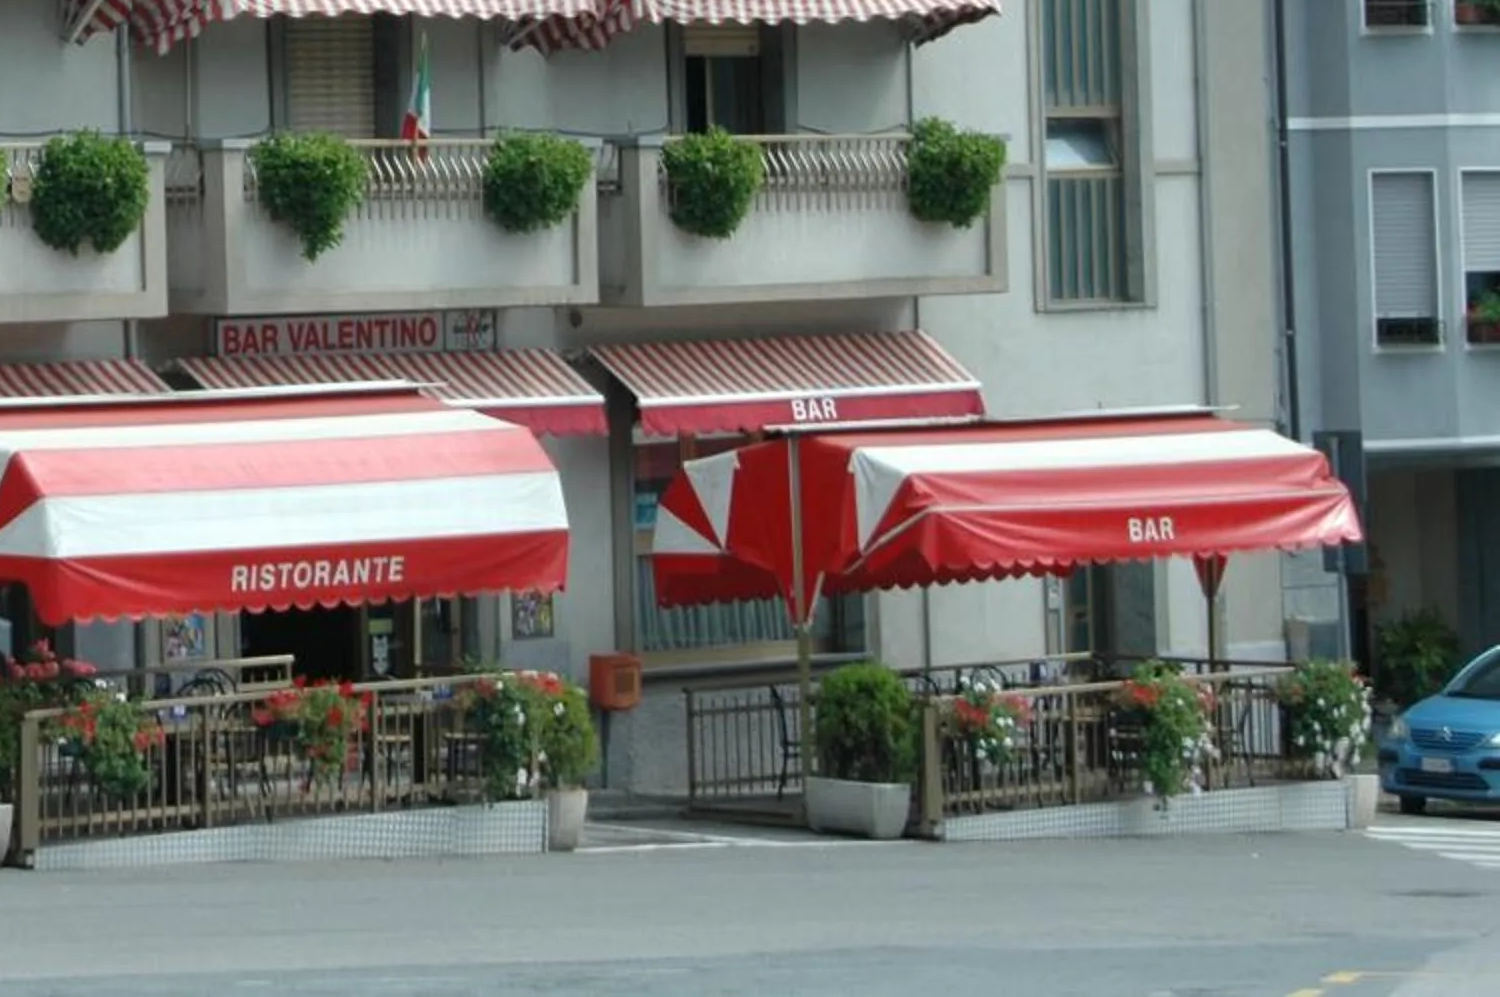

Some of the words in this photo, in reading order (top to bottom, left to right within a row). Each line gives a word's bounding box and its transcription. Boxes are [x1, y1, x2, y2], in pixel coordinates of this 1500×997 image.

[222, 324, 278, 353] BAR
[287, 316, 438, 350] VALENTINO
[790, 399, 838, 421] BAR
[1127, 516, 1175, 544] BAR
[231, 555, 405, 592] RISTORANTE
